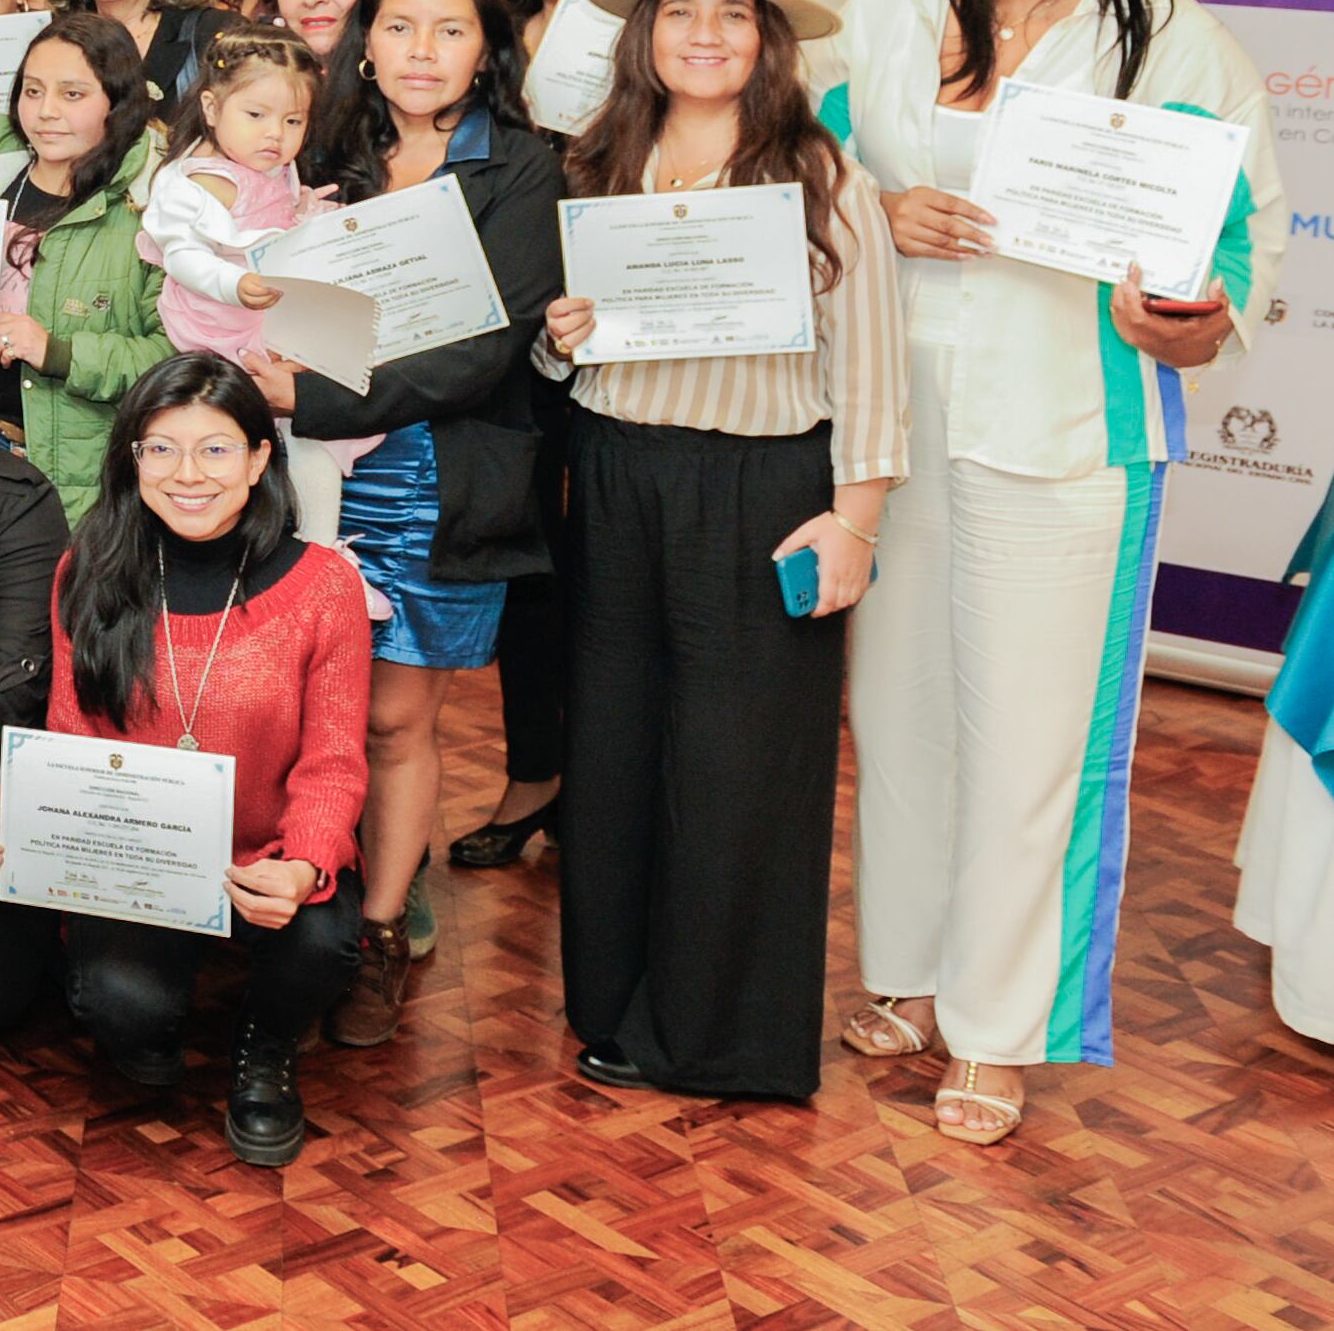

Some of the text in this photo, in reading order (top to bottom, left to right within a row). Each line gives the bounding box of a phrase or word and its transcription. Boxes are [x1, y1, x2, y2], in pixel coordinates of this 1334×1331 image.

[1189, 450, 1314, 477] EGISTRADURÍA
[37, 805, 70, 816] JOHANA
[73, 810, 121, 823] ALEXANDRA
[124, 816, 158, 828] ARMERO
[62, 835, 91, 845] PARIDAD
[93, 840, 123, 850] ESCUELA
[62, 844, 79, 852] PARA
[82, 846, 112, 857] MUJERES
